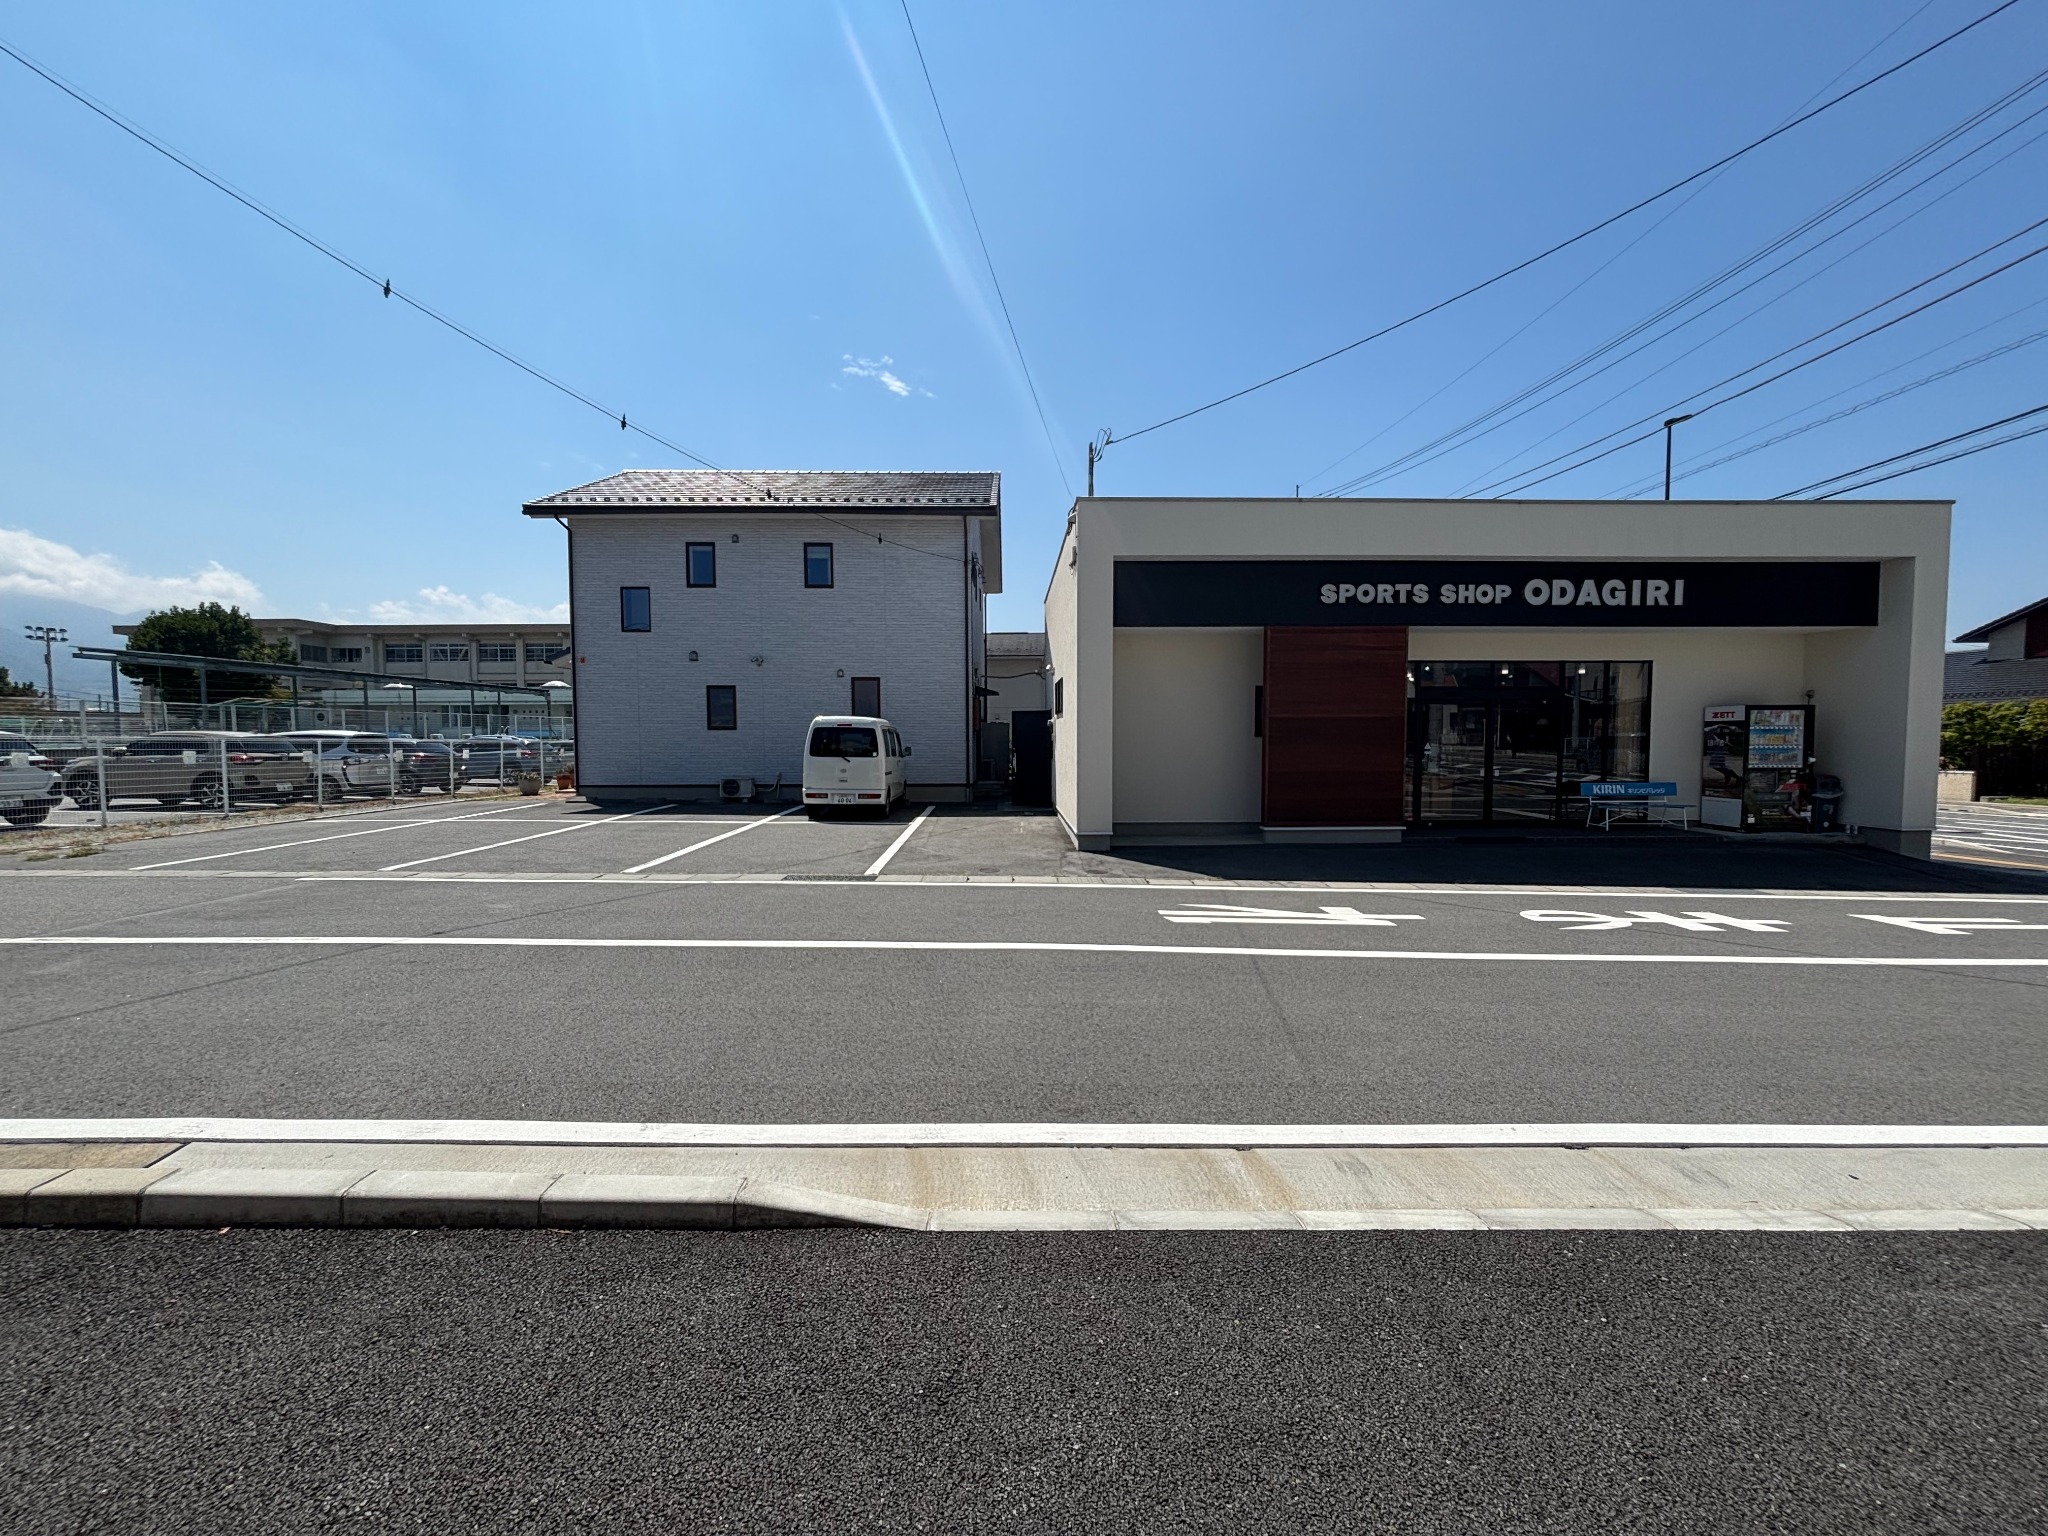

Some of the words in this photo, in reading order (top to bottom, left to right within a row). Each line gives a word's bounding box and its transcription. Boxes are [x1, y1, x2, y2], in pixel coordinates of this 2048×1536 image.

[1320, 583, 1430, 604] SPORTS
[1439, 583, 1512, 604] SHOP
[1523, 578, 1685, 607] ODAGIRI
[1712, 711, 1736, 719] ZETT
[1592, 784, 1625, 794] KIRIN
